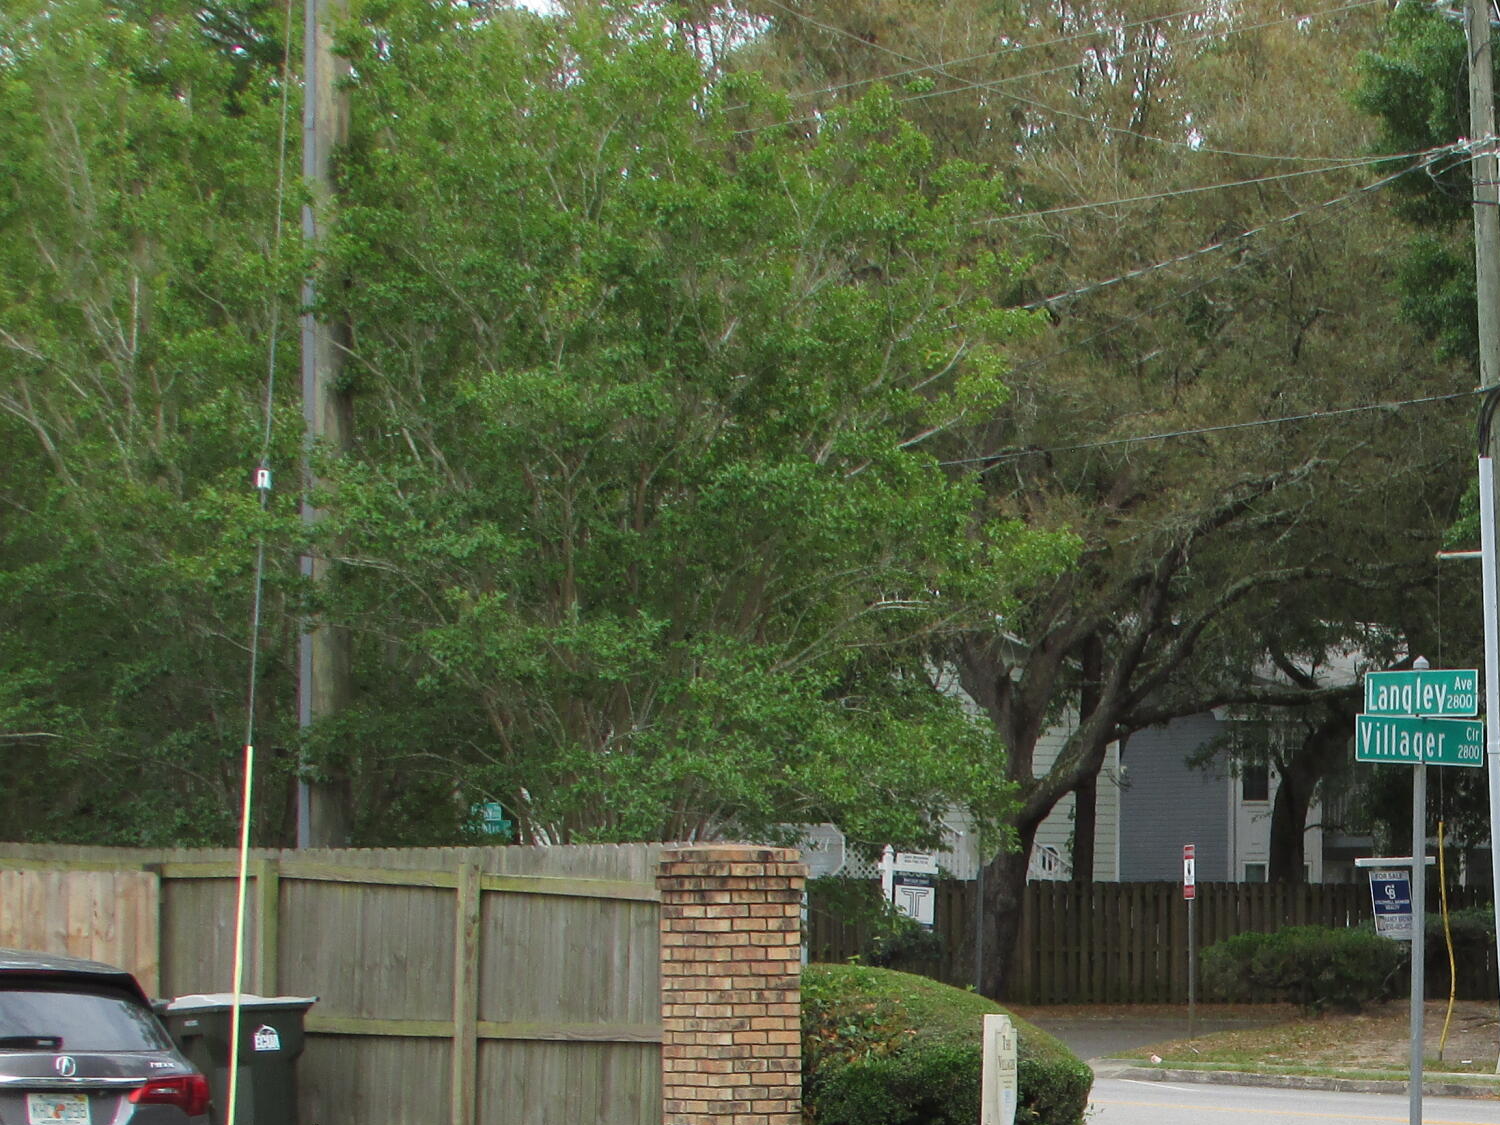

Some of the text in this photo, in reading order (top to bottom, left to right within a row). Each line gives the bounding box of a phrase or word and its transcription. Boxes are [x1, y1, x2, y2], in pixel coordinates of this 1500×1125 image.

[1368, 676, 1472, 714] Langley Ave
[1447, 694, 1473, 709] 2800
[1361, 721, 1479, 761] Villager Cir
[1457, 745, 1480, 760] 2800
[1375, 872, 1402, 880] FOR SALE
